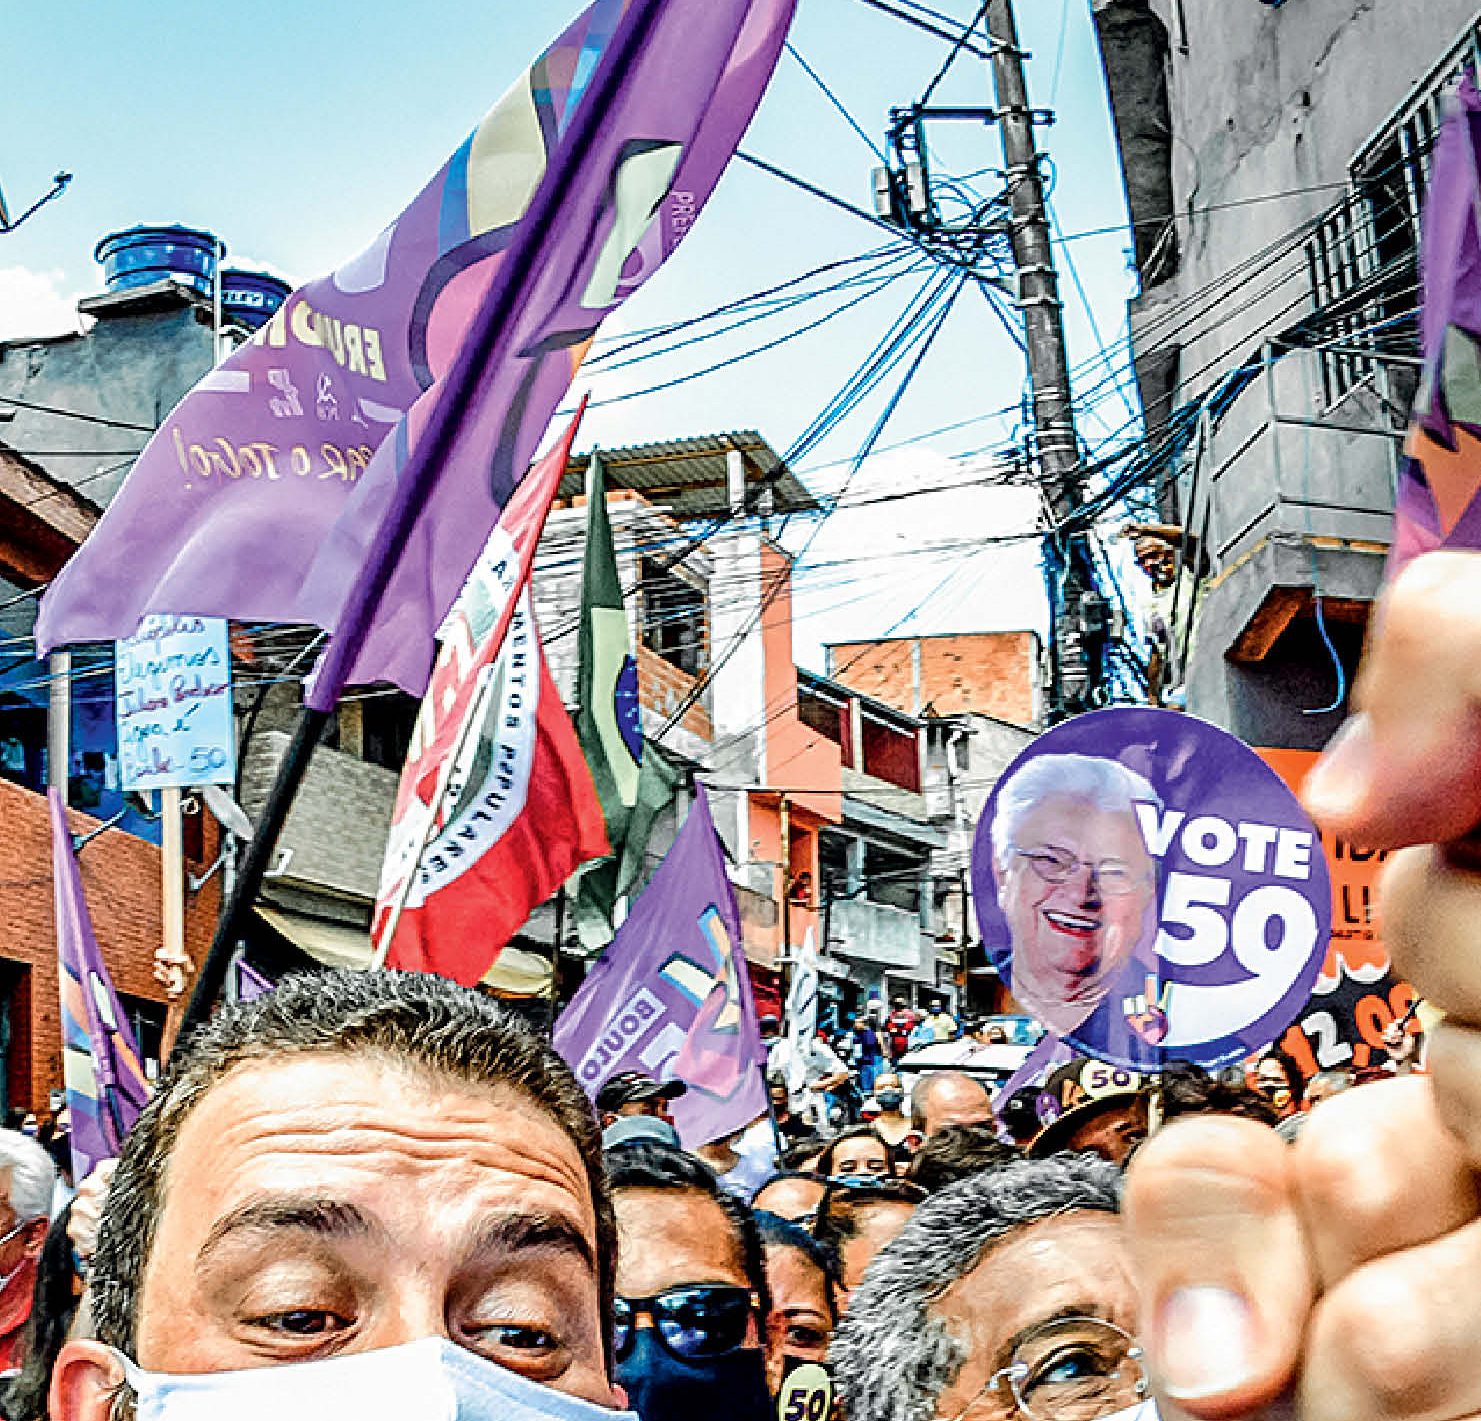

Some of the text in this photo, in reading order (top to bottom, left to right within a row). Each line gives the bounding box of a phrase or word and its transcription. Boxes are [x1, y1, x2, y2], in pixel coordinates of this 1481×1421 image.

[1134, 803, 1313, 881] VOTE
[1091, 1069, 1131, 1089] 50
[782, 1386, 827, 1421] 50
